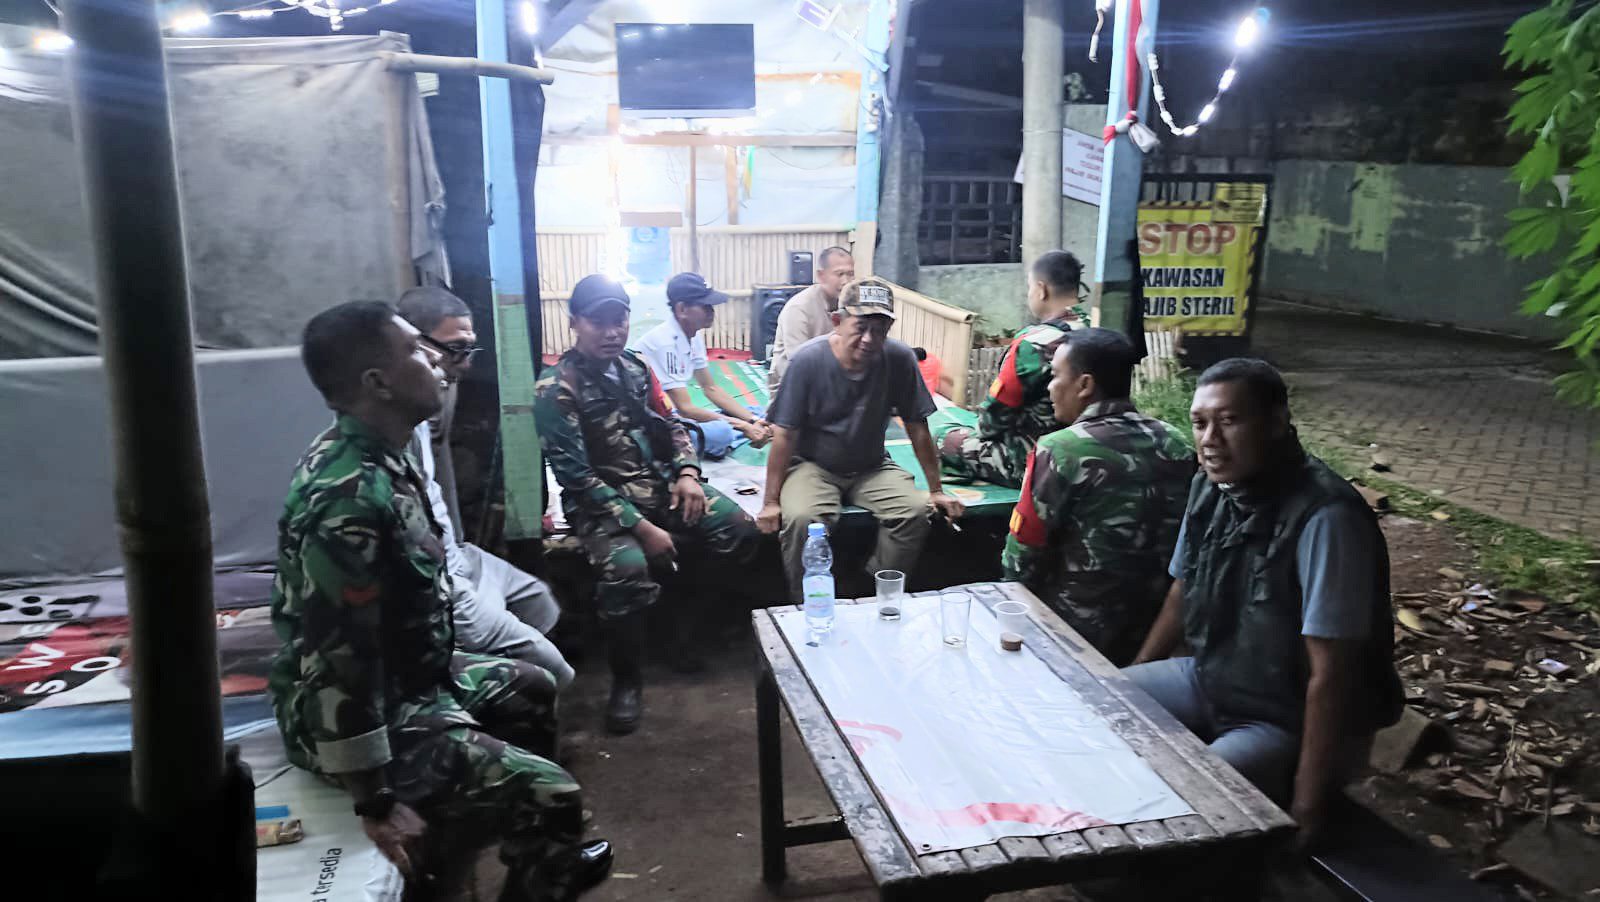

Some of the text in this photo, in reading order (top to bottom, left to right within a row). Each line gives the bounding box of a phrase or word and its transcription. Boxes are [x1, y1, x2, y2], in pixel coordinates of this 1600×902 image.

[1139, 223, 1236, 255] STOP
[1141, 268, 1225, 287] KAWASAN
[1143, 297, 1236, 316] AJIB STERIL
[310, 848, 342, 895] tersedia
